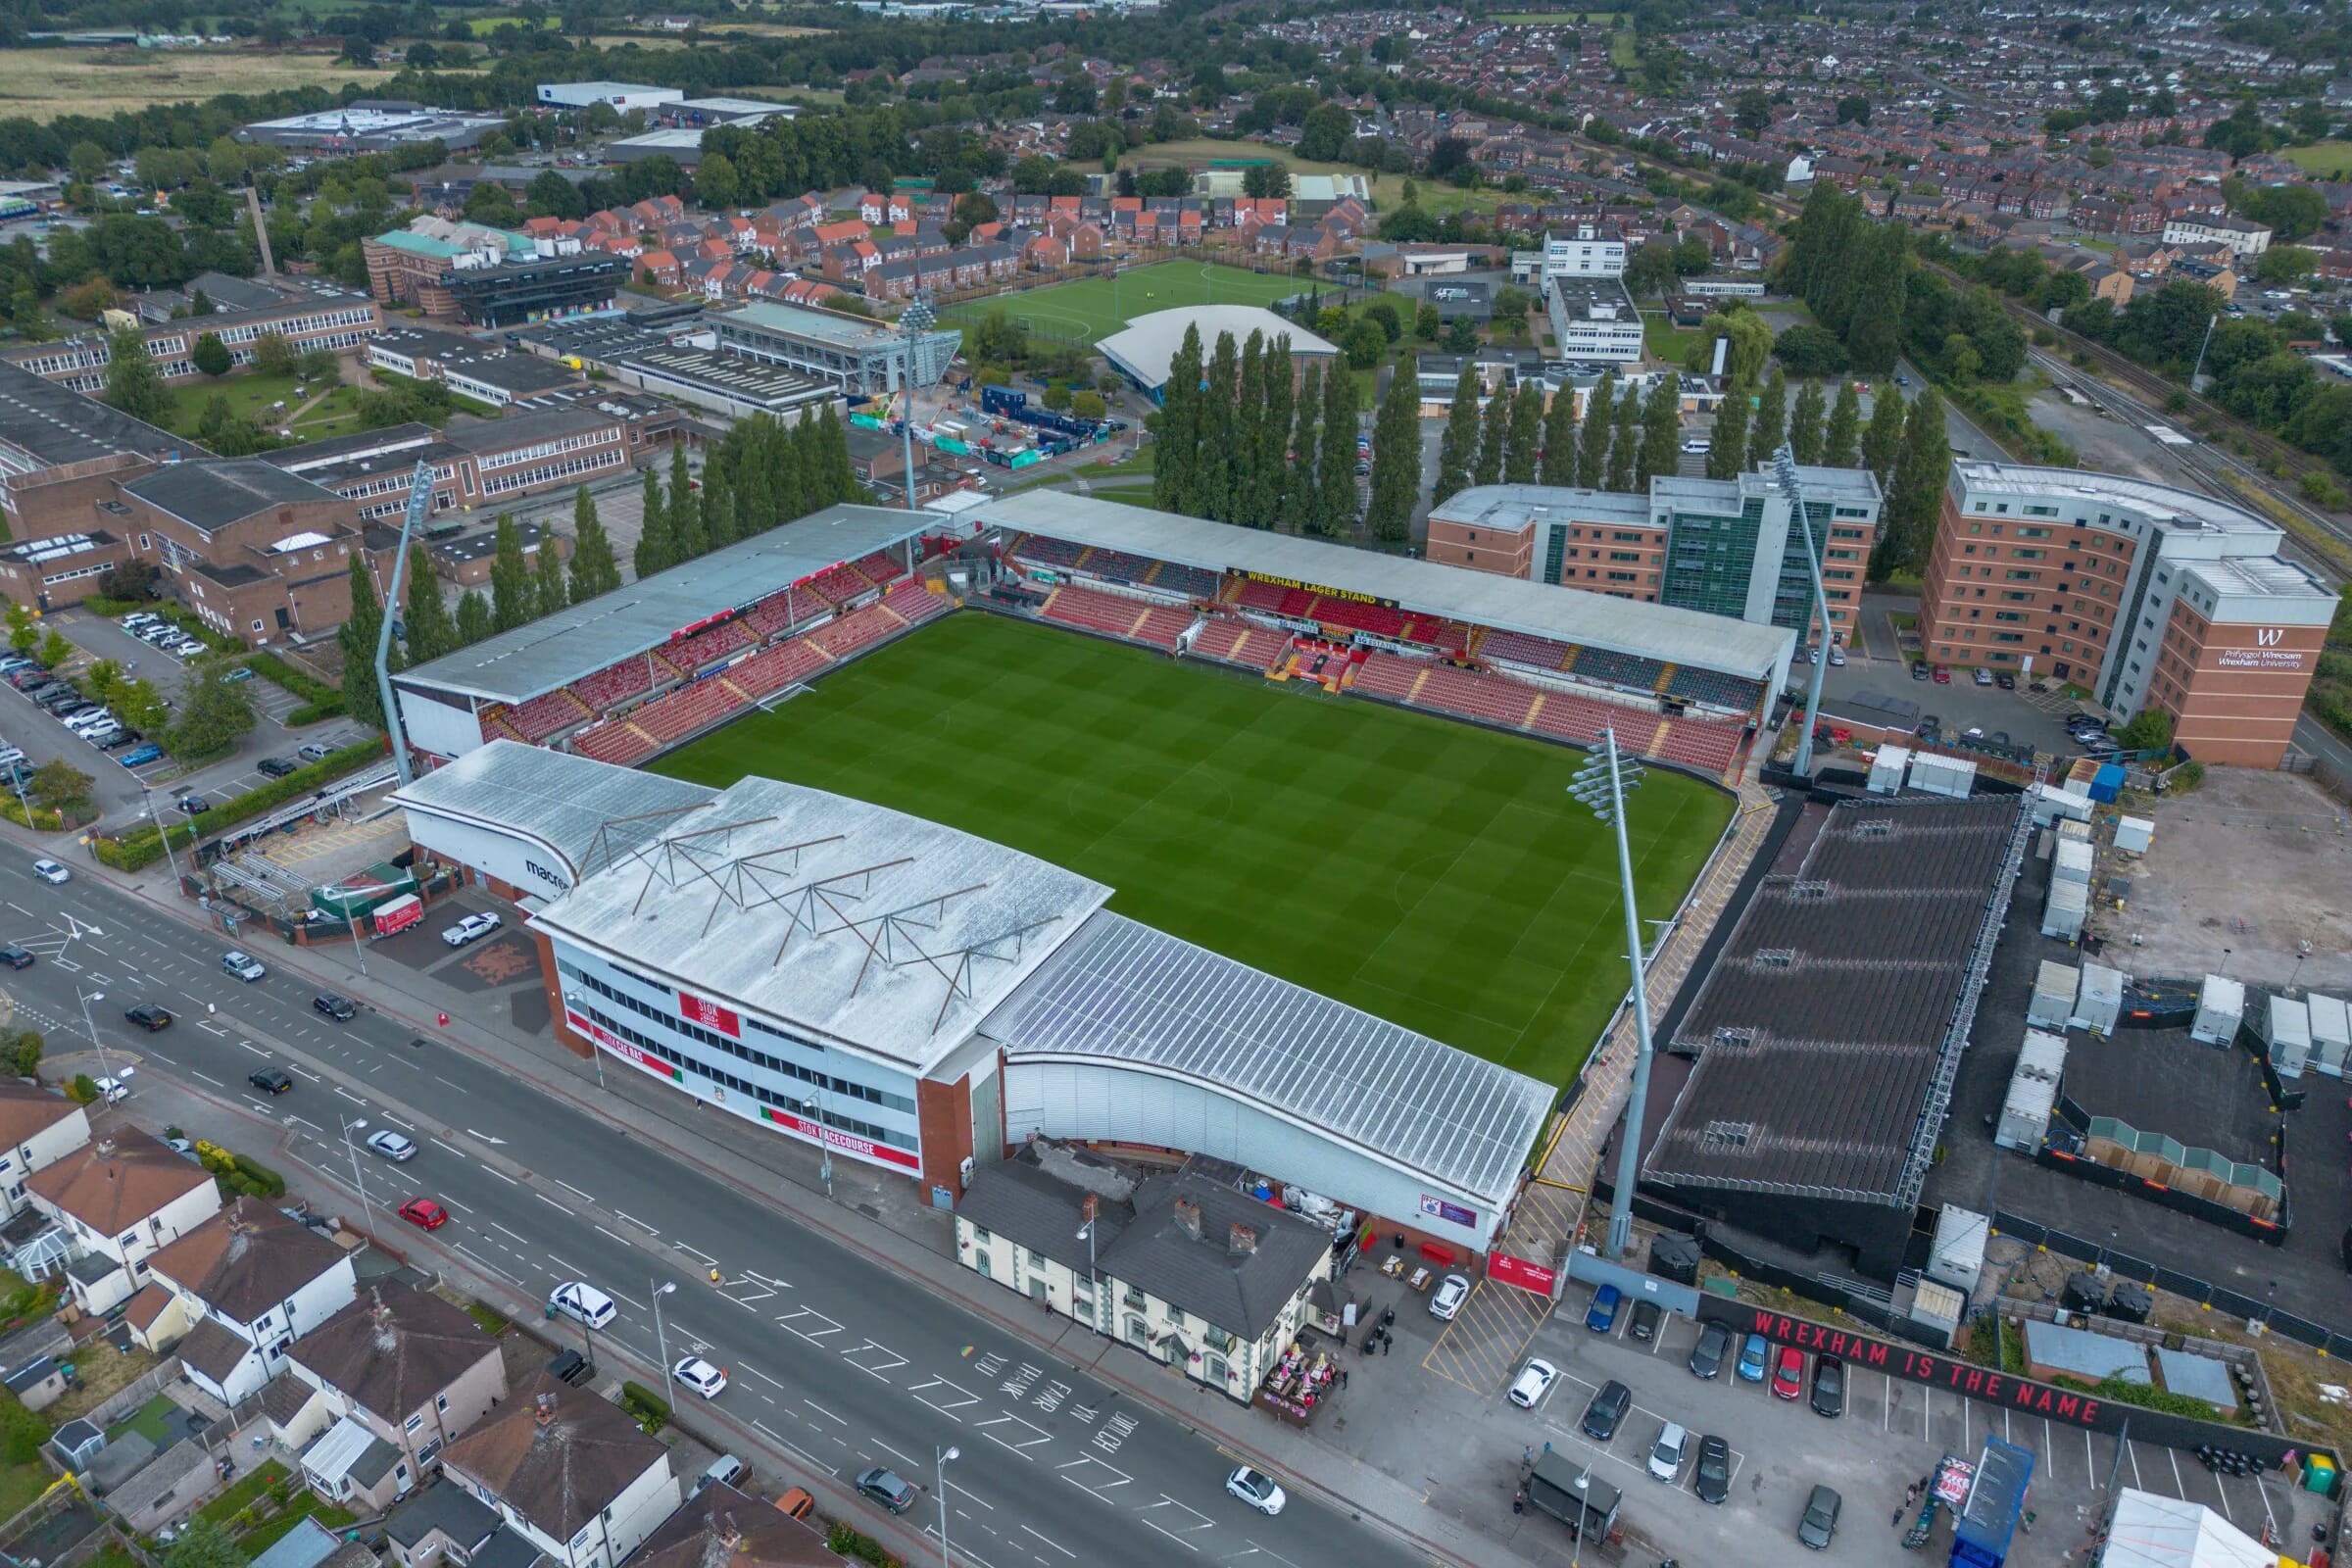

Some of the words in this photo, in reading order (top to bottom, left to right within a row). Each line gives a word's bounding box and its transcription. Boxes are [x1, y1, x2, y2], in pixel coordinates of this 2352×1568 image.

[1248, 571, 1301, 589] WREXHAM
[1303, 583, 1338, 597] LAGER
[1340, 590, 1376, 605] STAND
[1290, 622, 1317, 633] ESTATES
[2258, 628, 2284, 646] W
[1368, 639, 1397, 650] ESTATES
[2225, 650, 2261, 660] Prifysgol
[2262, 651, 2302, 660] Wrecsam
[2260, 660, 2301, 669] University
[974, 1351, 1009, 1378] YOU
[1755, 1311, 1887, 1366] WREXHAM
[1905, 1353, 1934, 1378] IS
[1951, 1365, 2002, 1397] THE
[2015, 1385, 2099, 1423] NAME
[998, 1362, 1044, 1400] THANK
[1031, 1379, 1072, 1413] FAWR
[1069, 1403, 1099, 1424] YN
[1091, 1410, 1140, 1454] DIOLCH
